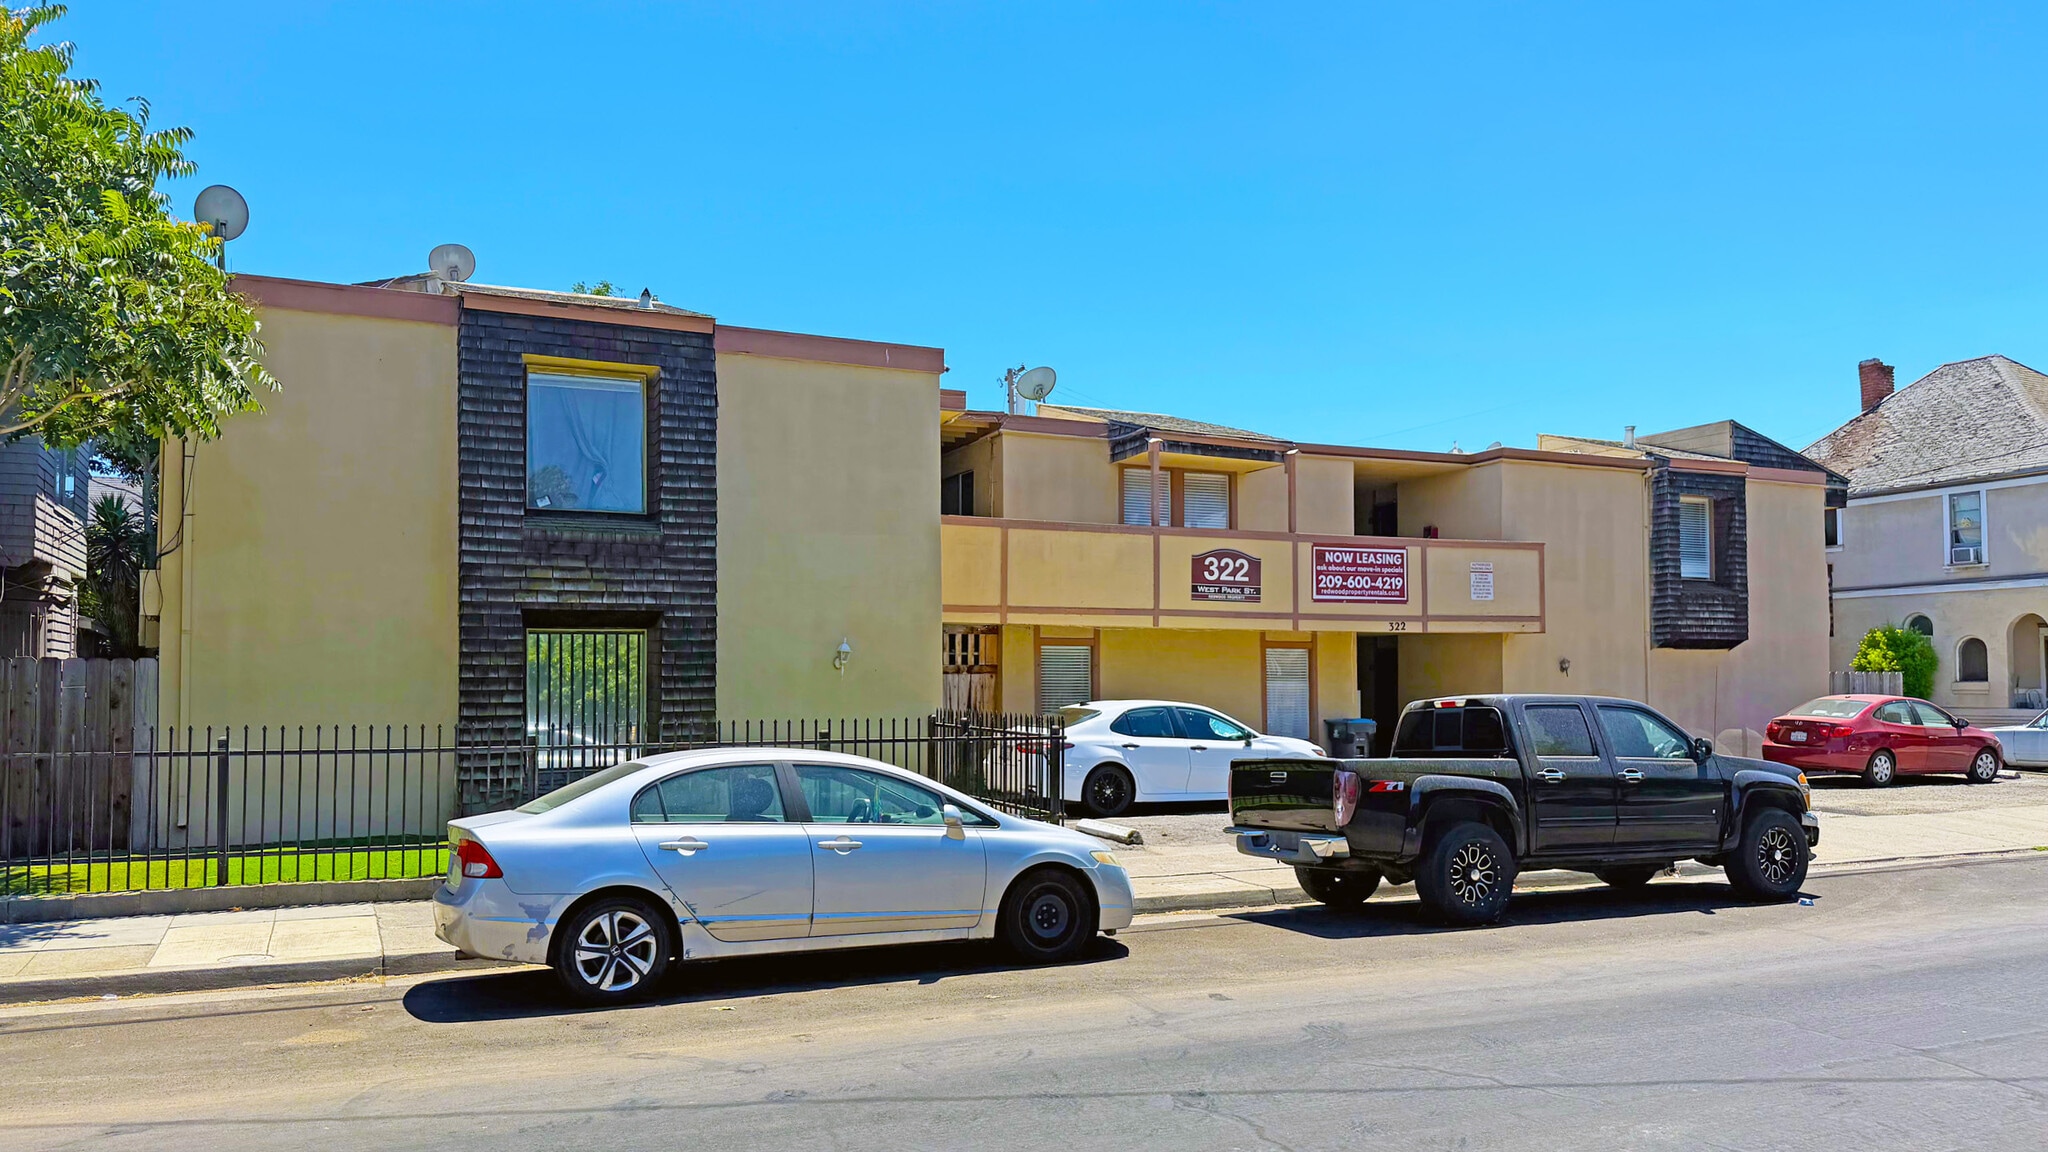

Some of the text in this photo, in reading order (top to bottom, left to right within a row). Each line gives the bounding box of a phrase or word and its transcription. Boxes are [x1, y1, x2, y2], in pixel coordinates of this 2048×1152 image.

[1325, 552, 1402, 565] NOW LEASING
[1203, 556, 1249, 582] 322
[1328, 564, 1346, 572] about
[1357, 565, 1381, 573] move-in
[1381, 566, 1404, 574] specials
[1318, 575, 1404, 590] 209-600-4219
[1197, 585, 1257, 595] WEST PARK ST.
[1321, 588, 1400, 597] redwoodpropertyrentals.com
[1389, 621, 1406, 631] 322
[1369, 780, 1404, 792] Z71
